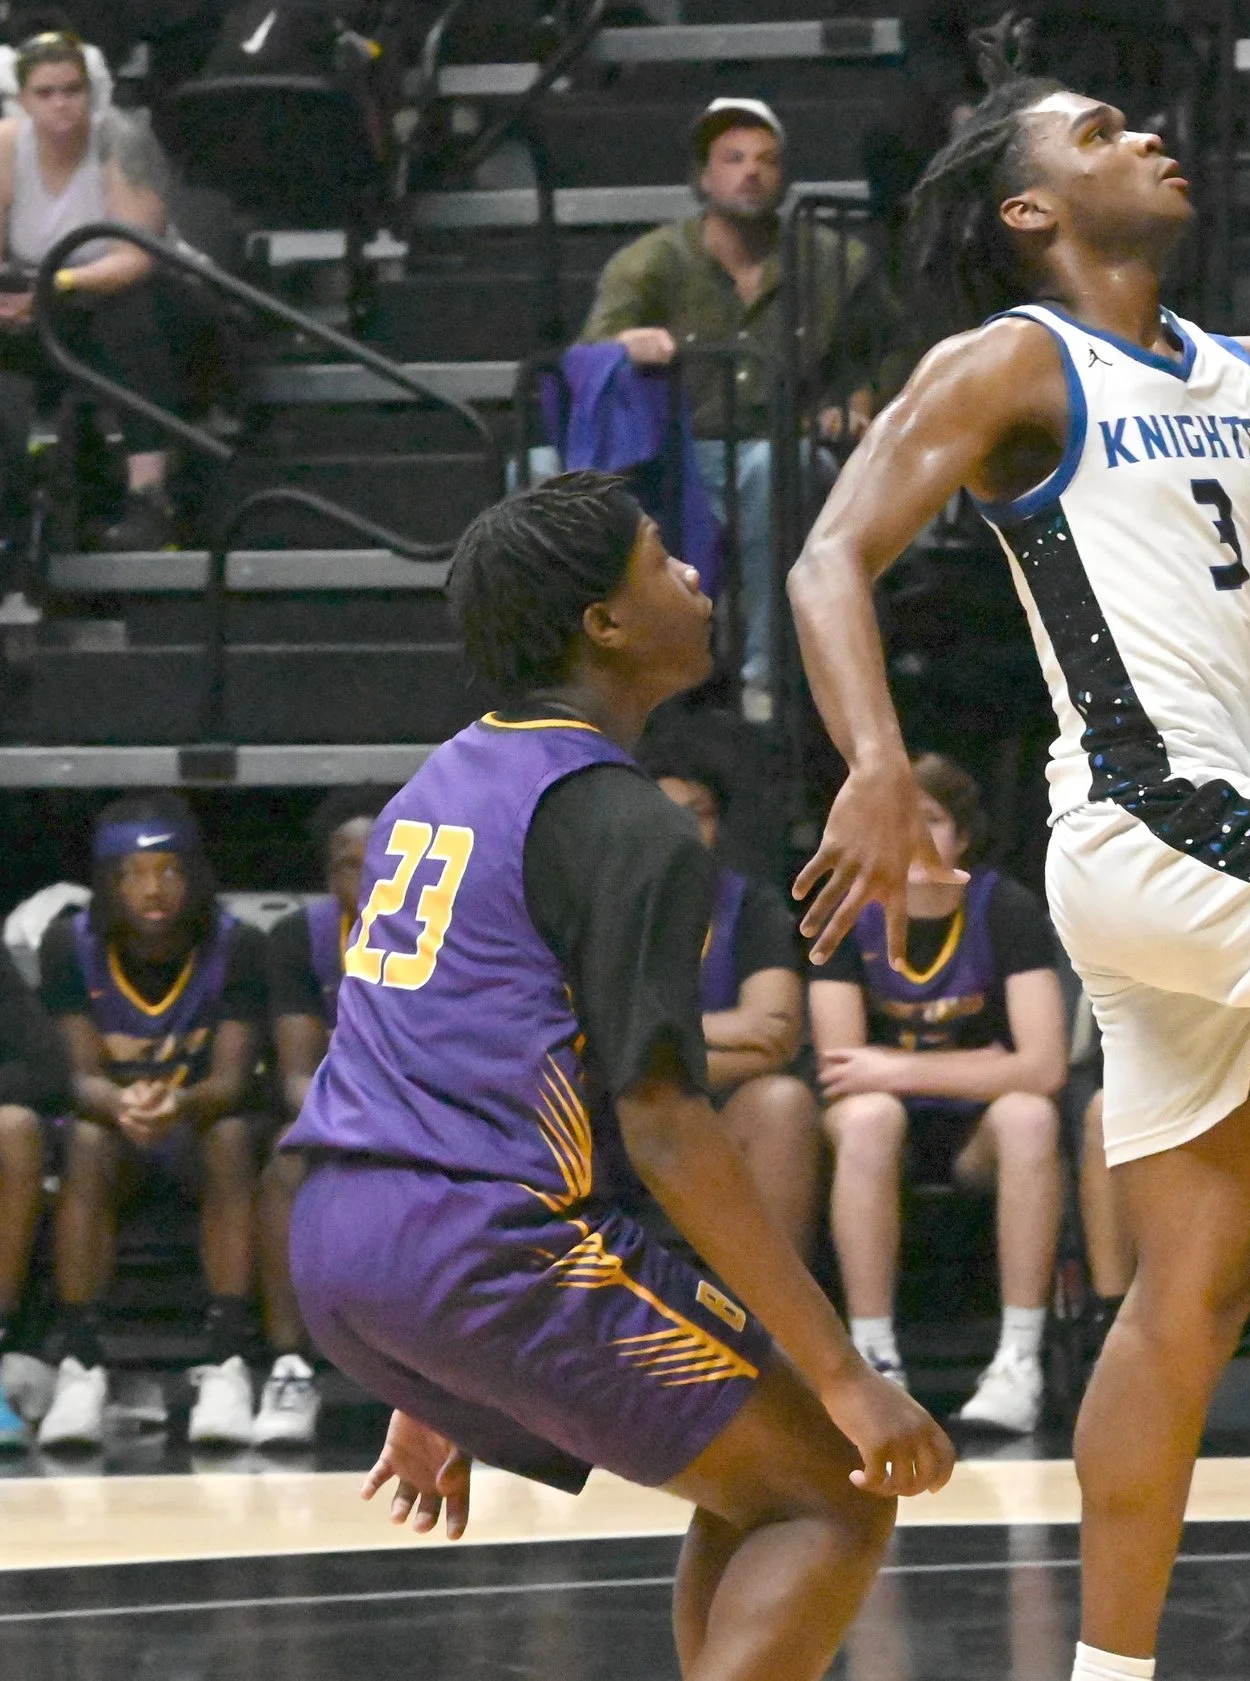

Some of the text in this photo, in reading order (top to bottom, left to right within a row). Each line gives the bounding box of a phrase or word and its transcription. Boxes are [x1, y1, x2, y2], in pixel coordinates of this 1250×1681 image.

[1190, 478, 1250, 591] 3
[345, 819, 474, 991] 23
[695, 1279, 746, 1332] B
